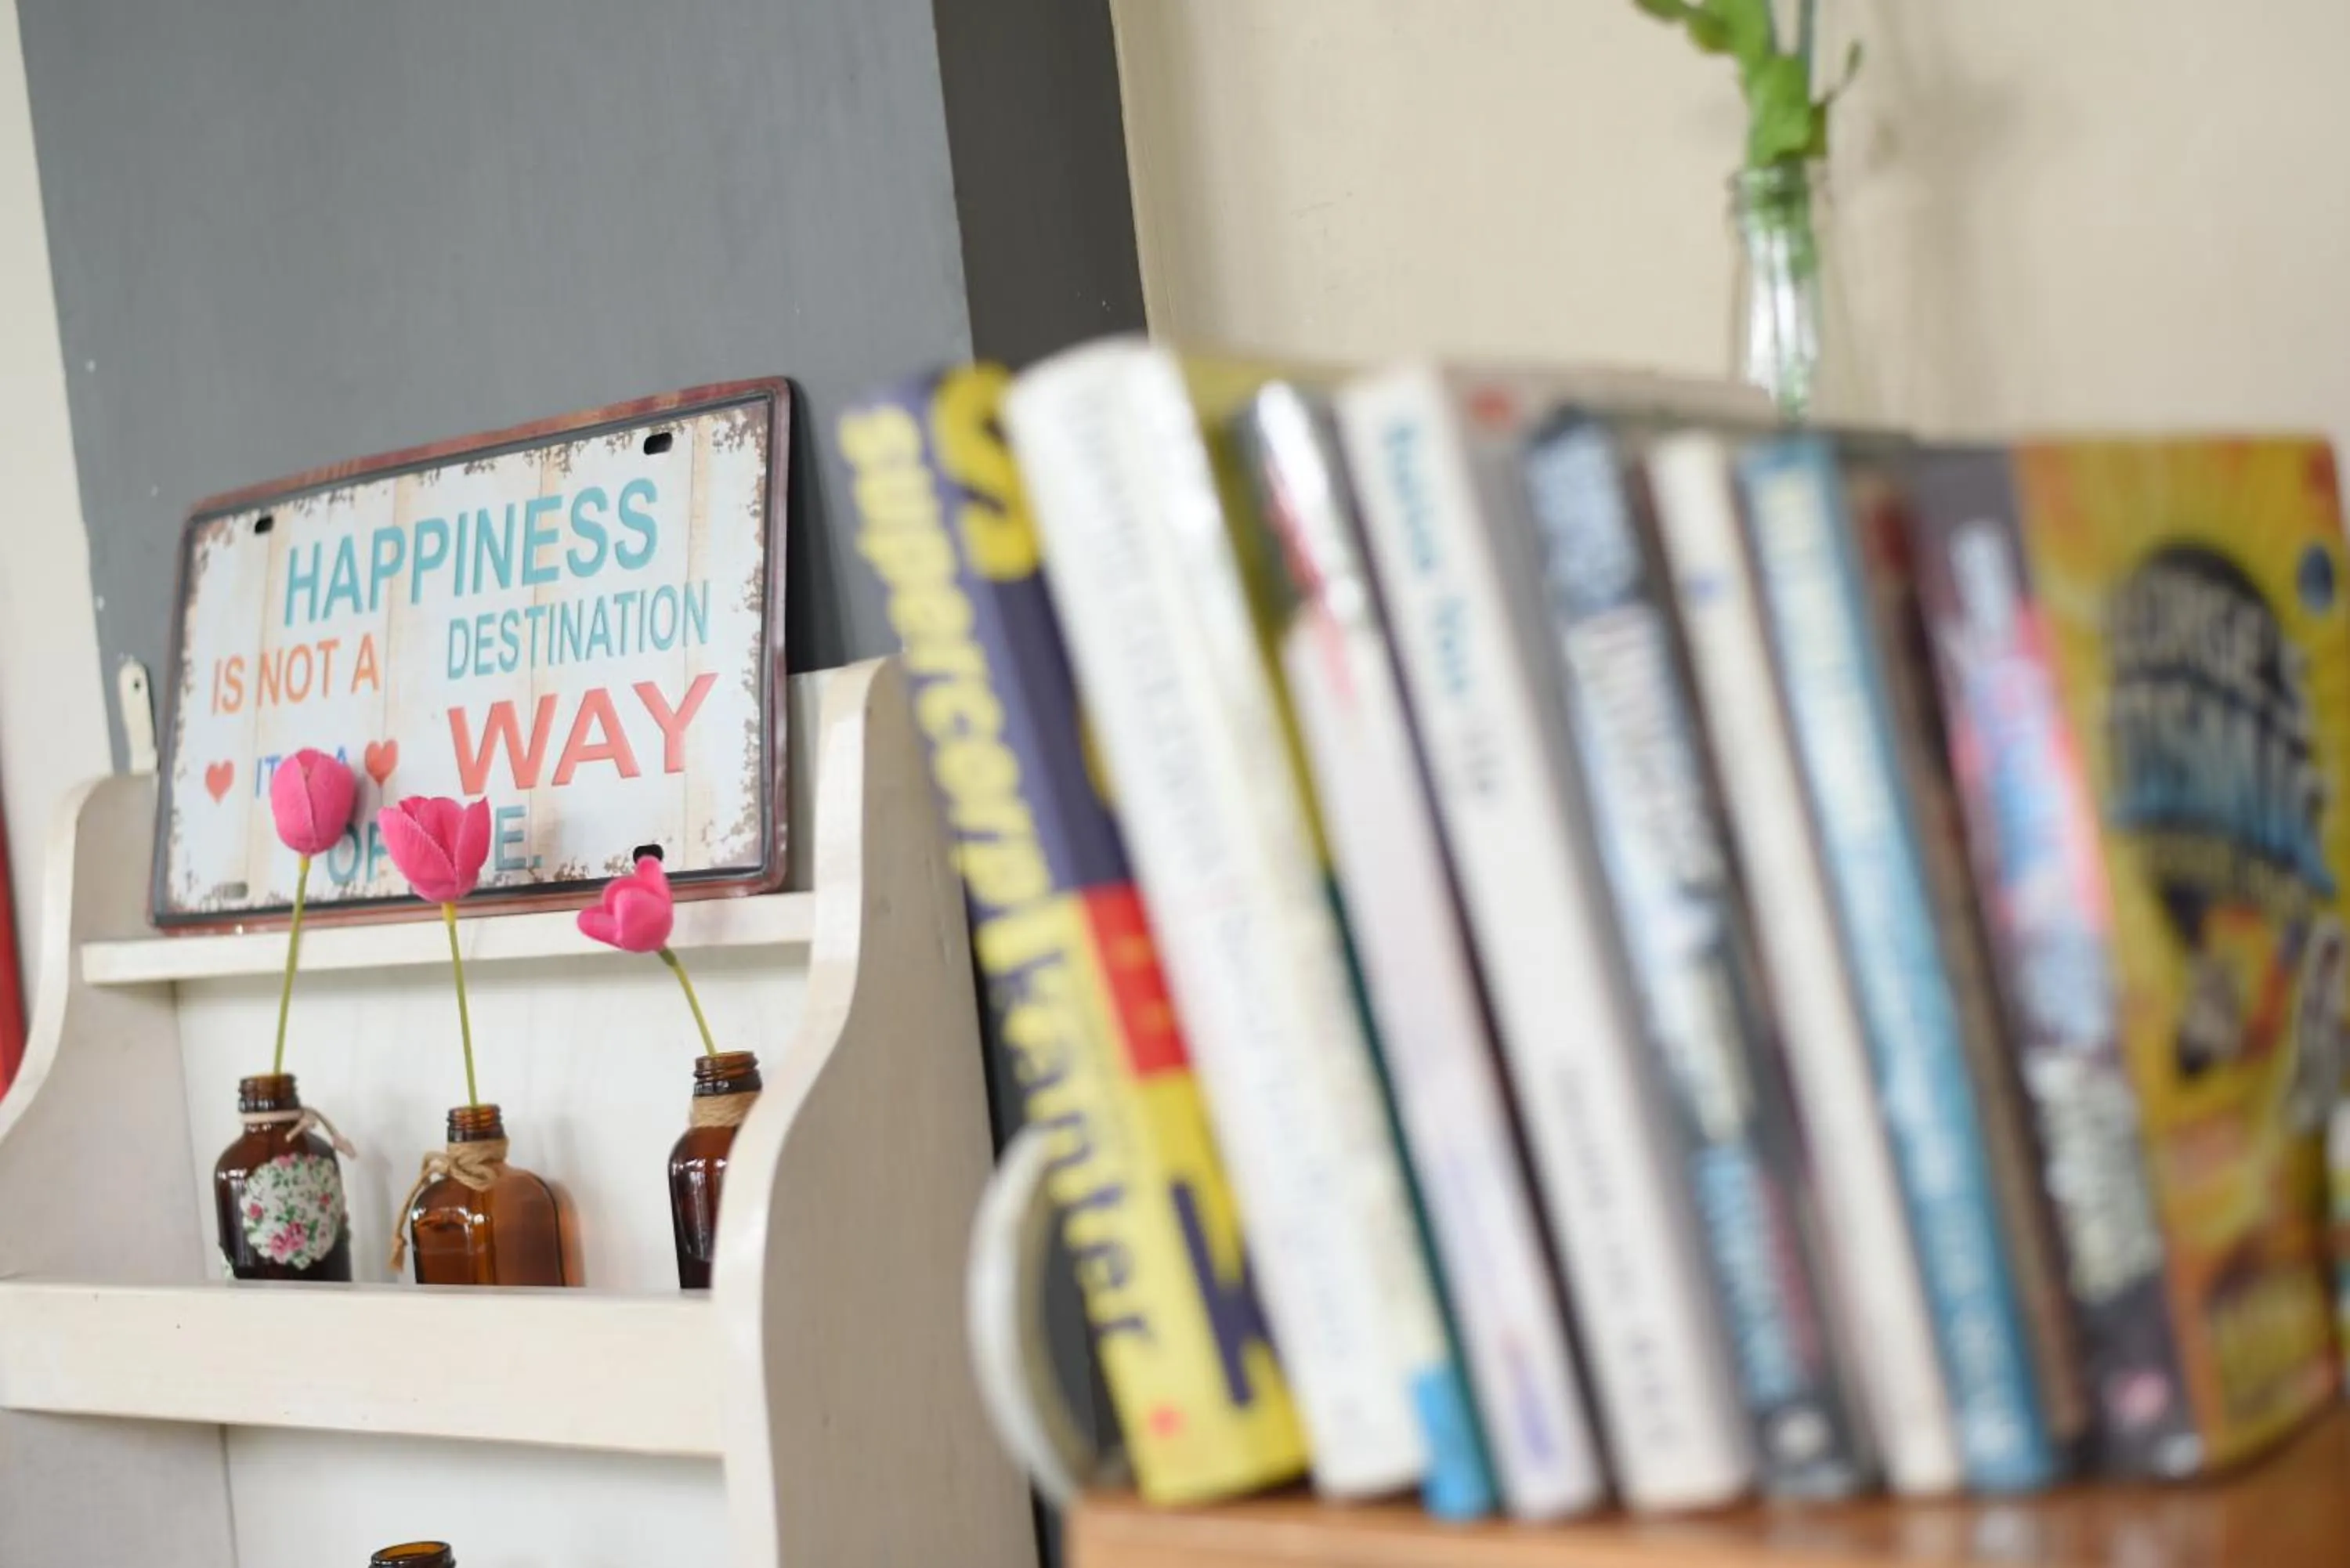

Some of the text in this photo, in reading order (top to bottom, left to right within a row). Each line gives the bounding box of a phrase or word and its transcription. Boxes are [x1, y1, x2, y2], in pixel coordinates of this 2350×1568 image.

[284, 478, 659, 627] HAPPINESS
[212, 580, 710, 716] IS NOT A DESTINATION
[446, 672, 720, 797] WAY
[327, 822, 389, 886] OF
